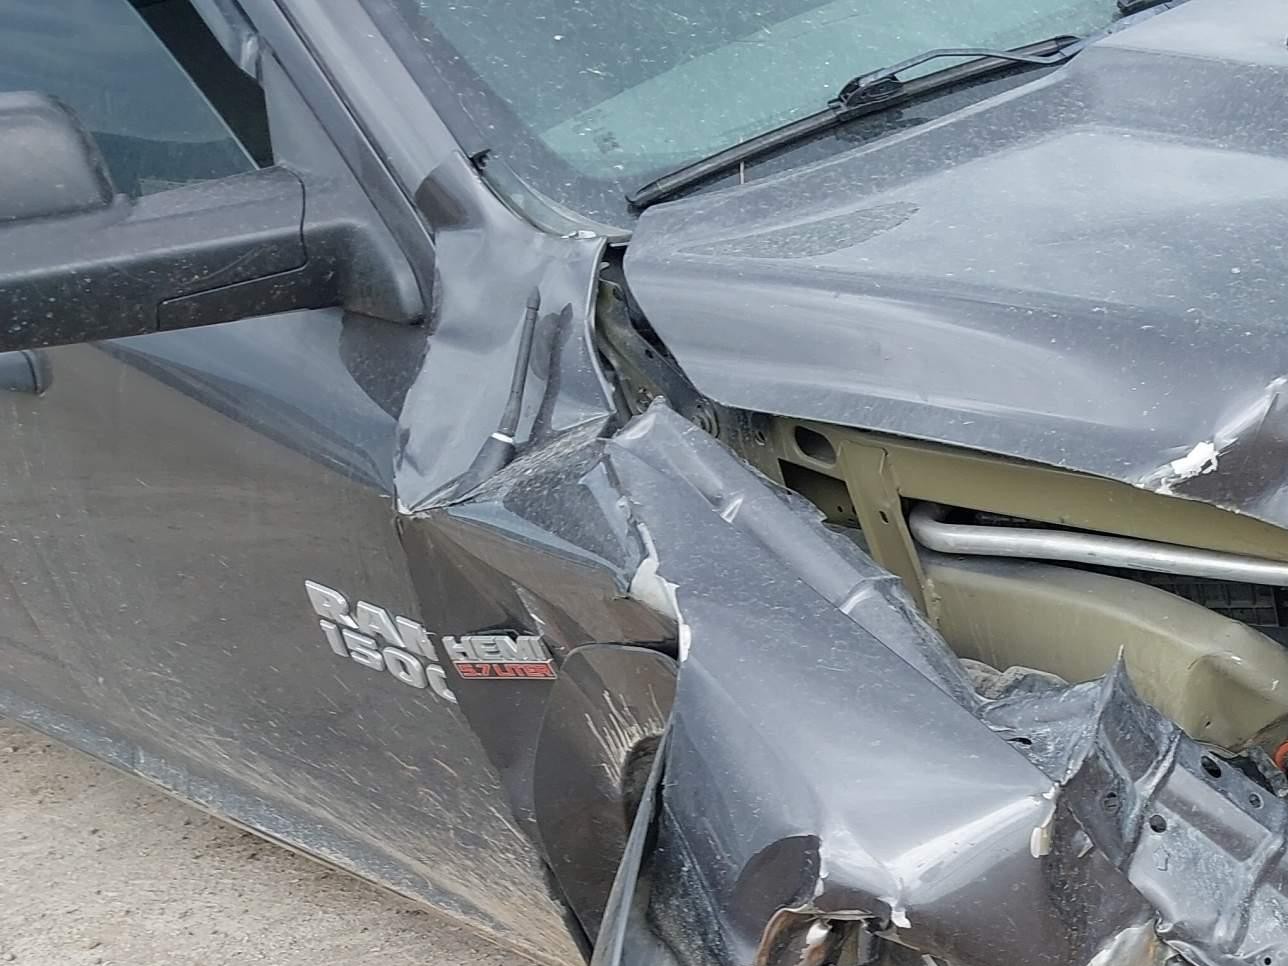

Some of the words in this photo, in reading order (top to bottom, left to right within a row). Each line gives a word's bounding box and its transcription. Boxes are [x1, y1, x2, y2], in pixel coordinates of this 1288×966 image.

[442, 635, 547, 661] HEMI
[459, 662, 491, 677] 5.7
[492, 662, 552, 677] LITER
